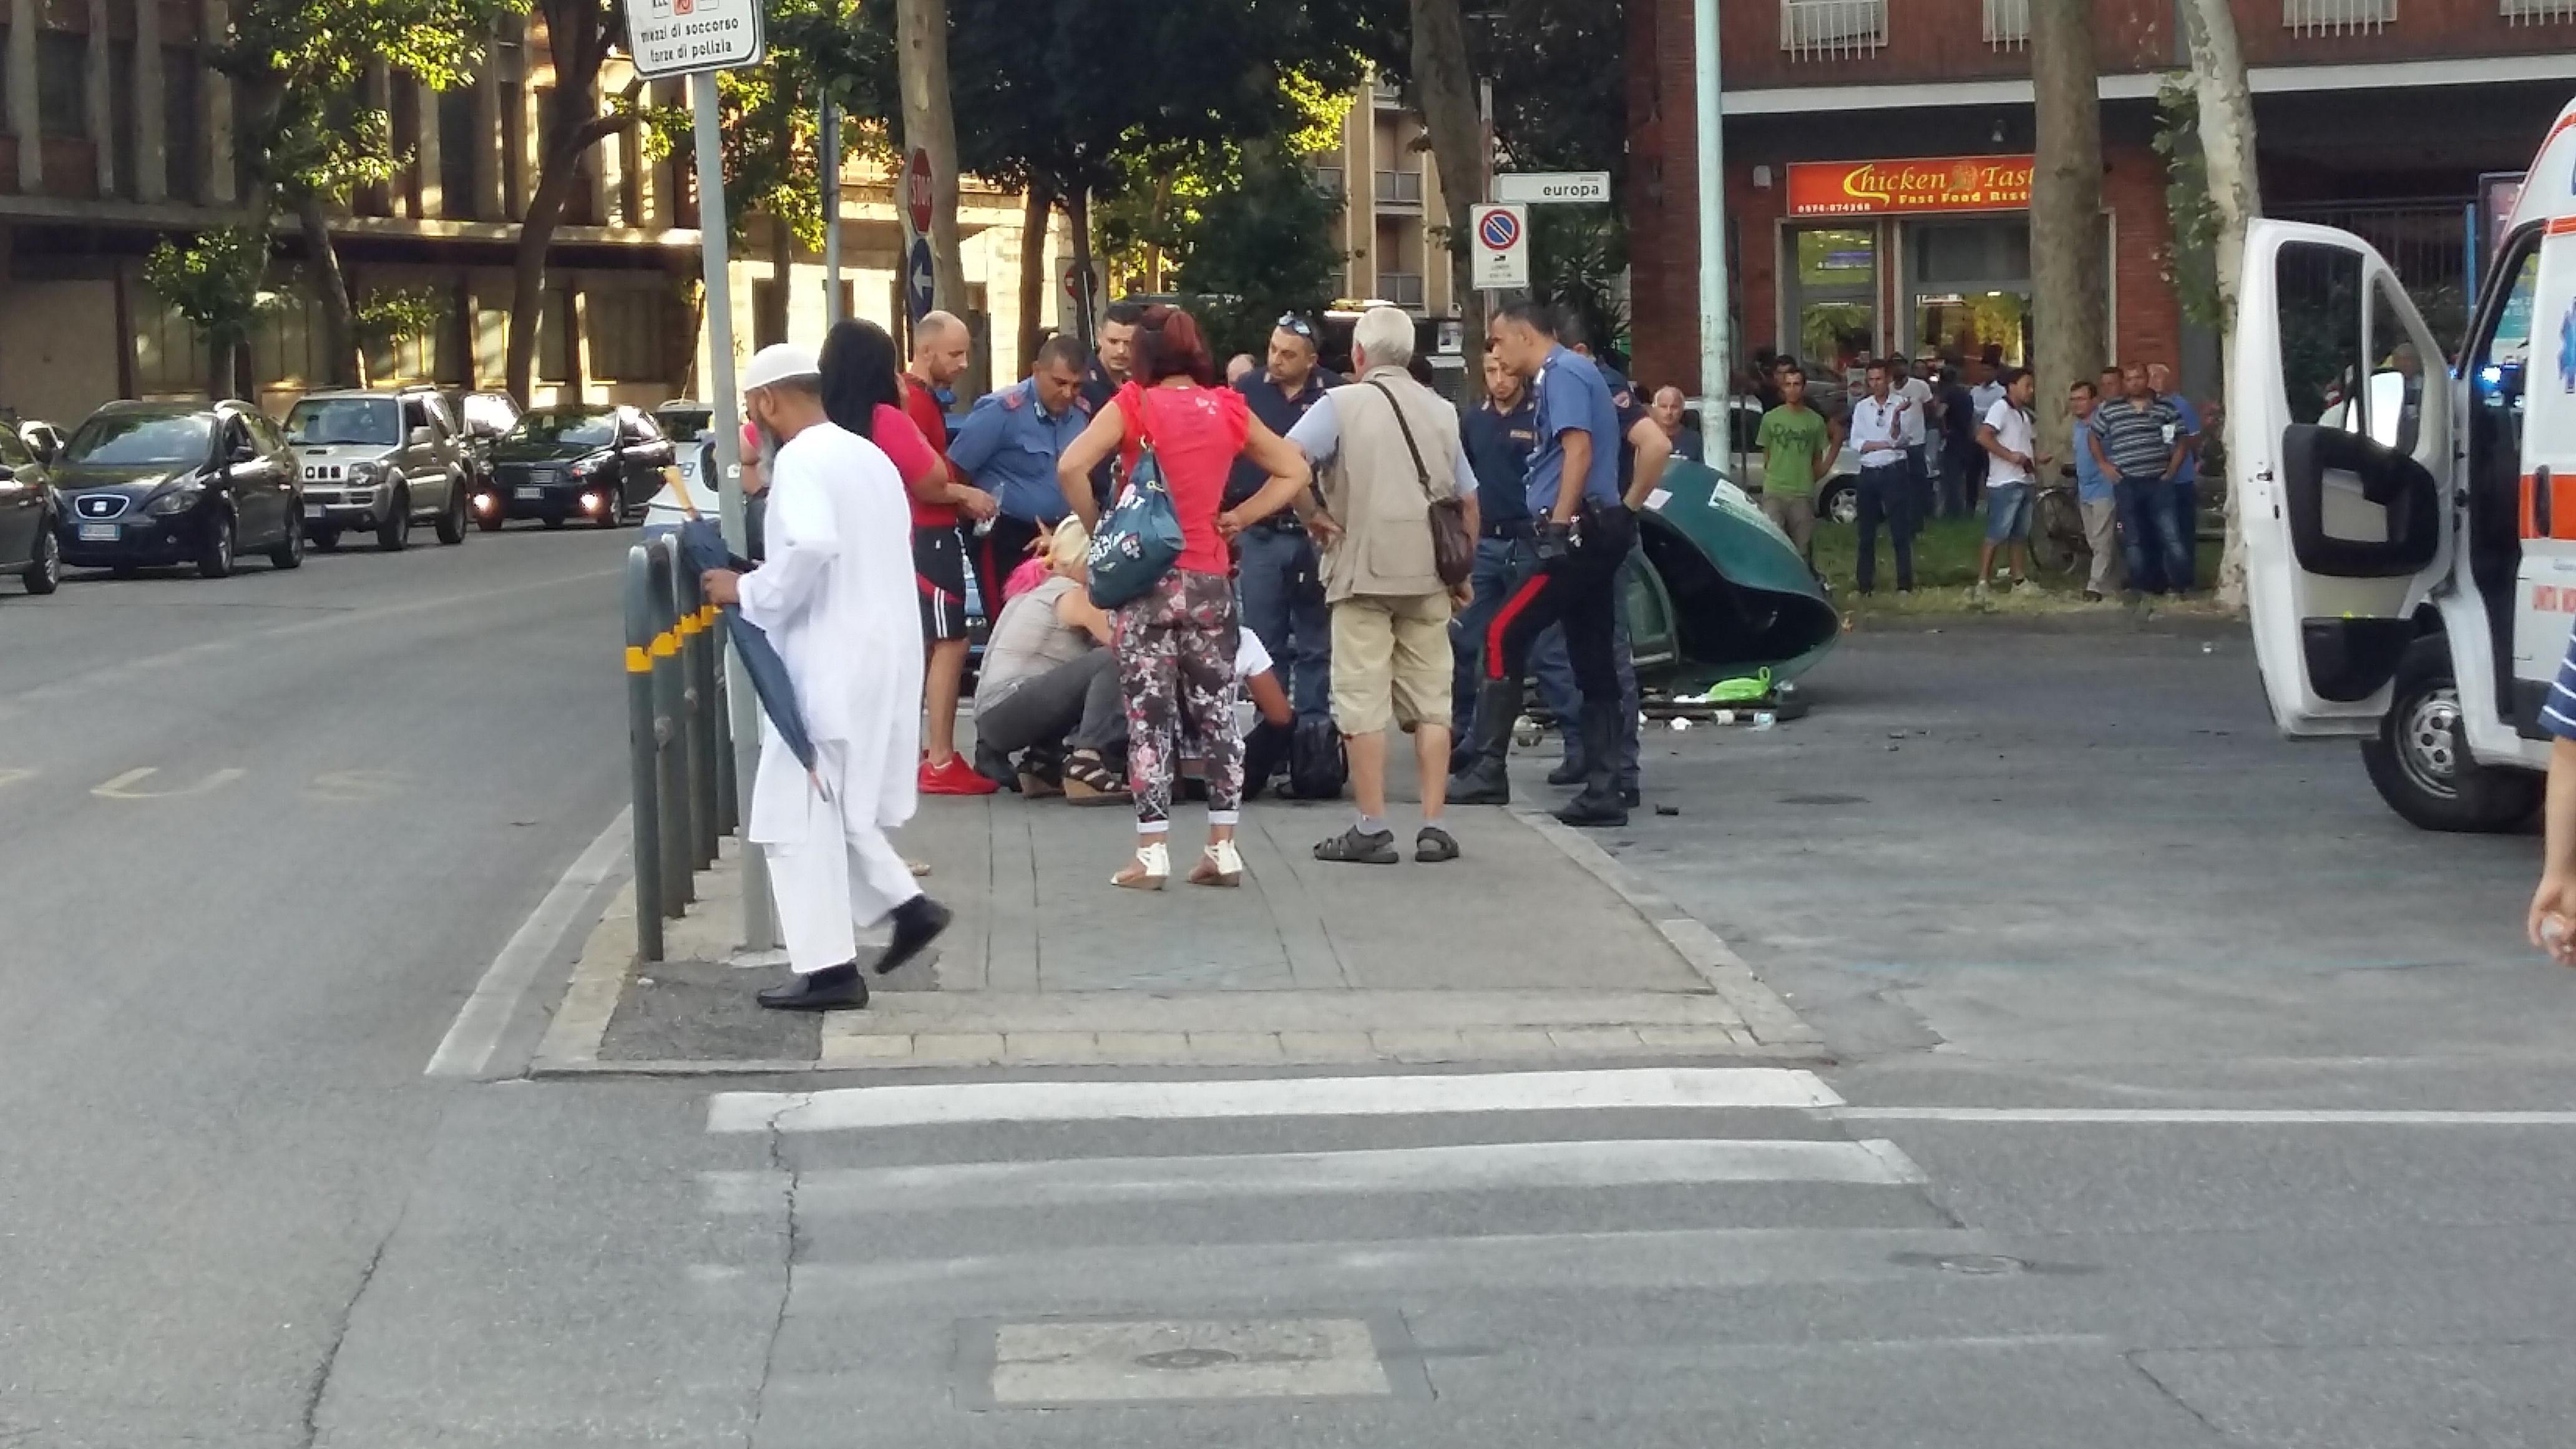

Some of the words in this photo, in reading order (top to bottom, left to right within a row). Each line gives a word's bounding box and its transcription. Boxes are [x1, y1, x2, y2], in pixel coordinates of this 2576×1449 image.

[671, 22, 681, 38] di
[686, 17, 739, 36] soccorso
[677, 44, 687, 59] di
[692, 38, 733, 59] polizia
[1543, 185, 1599, 197] europa
[1843, 163, 1947, 207] Chicken
